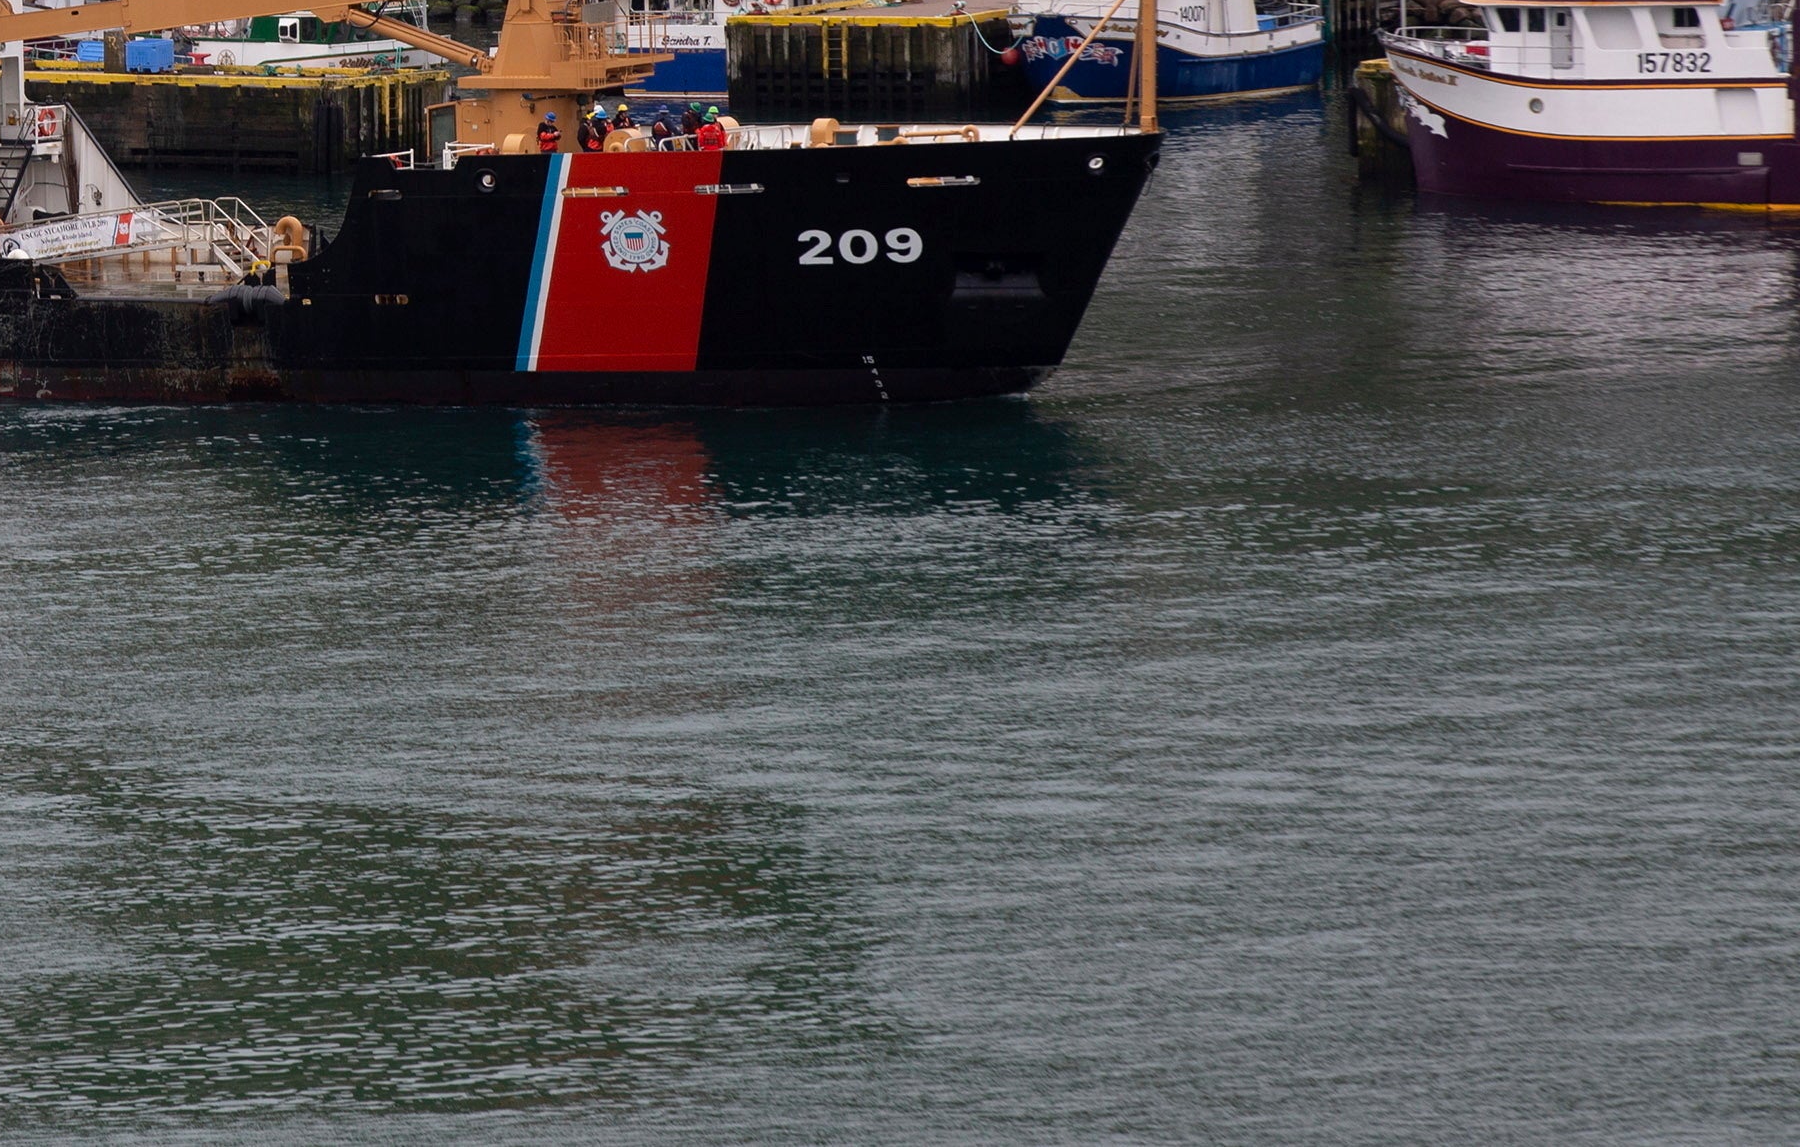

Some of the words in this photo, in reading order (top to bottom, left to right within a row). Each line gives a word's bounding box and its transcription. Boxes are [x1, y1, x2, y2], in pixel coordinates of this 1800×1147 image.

[661, 36, 700, 46] Sandra
[703, 36, 712, 46] T.
[1638, 52, 1711, 73] 157832
[44, 222, 80, 236] SYCAMORE
[798, 227, 924, 265] 209
[862, 356, 875, 364] 15
[874, 380, 884, 388] 3
[880, 391, 889, 400] 2
